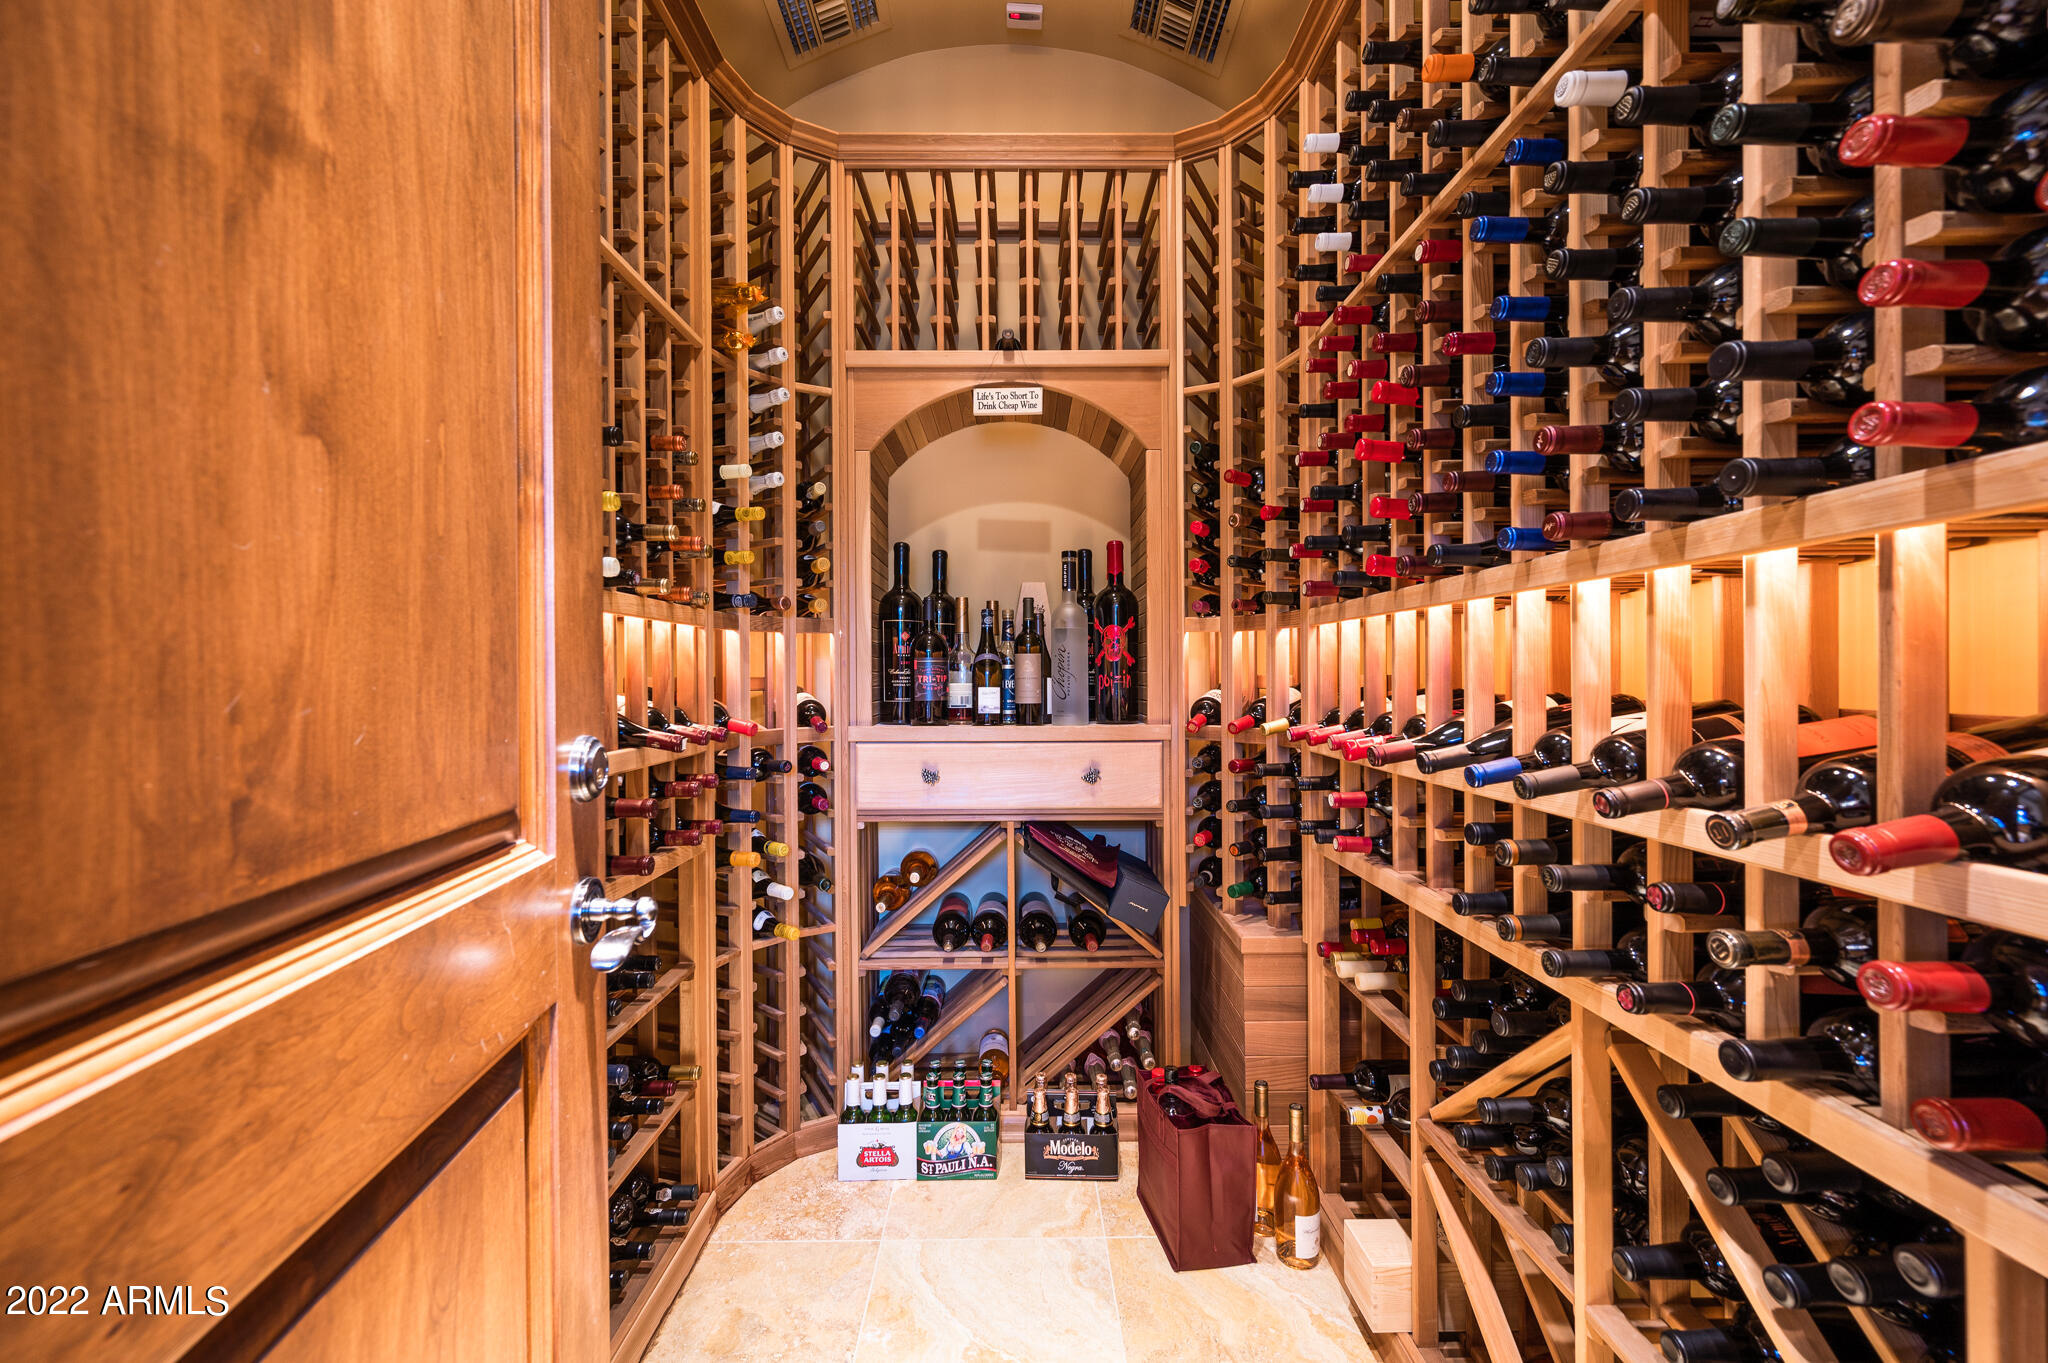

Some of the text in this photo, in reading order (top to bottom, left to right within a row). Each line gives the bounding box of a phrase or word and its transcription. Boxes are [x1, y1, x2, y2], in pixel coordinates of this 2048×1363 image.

[976, 390, 1039, 401] Life's Too Short To
[978, 400, 1038, 411] Drink Cheap Wine
[917, 674, 948, 683] TRI-TIP
[1051, 644, 1077, 700] Chopin
[1049, 1139, 1093, 1156] Modelo
[934, 1158, 967, 1175] PAULI
[967, 1154, 993, 1170] N.A.
